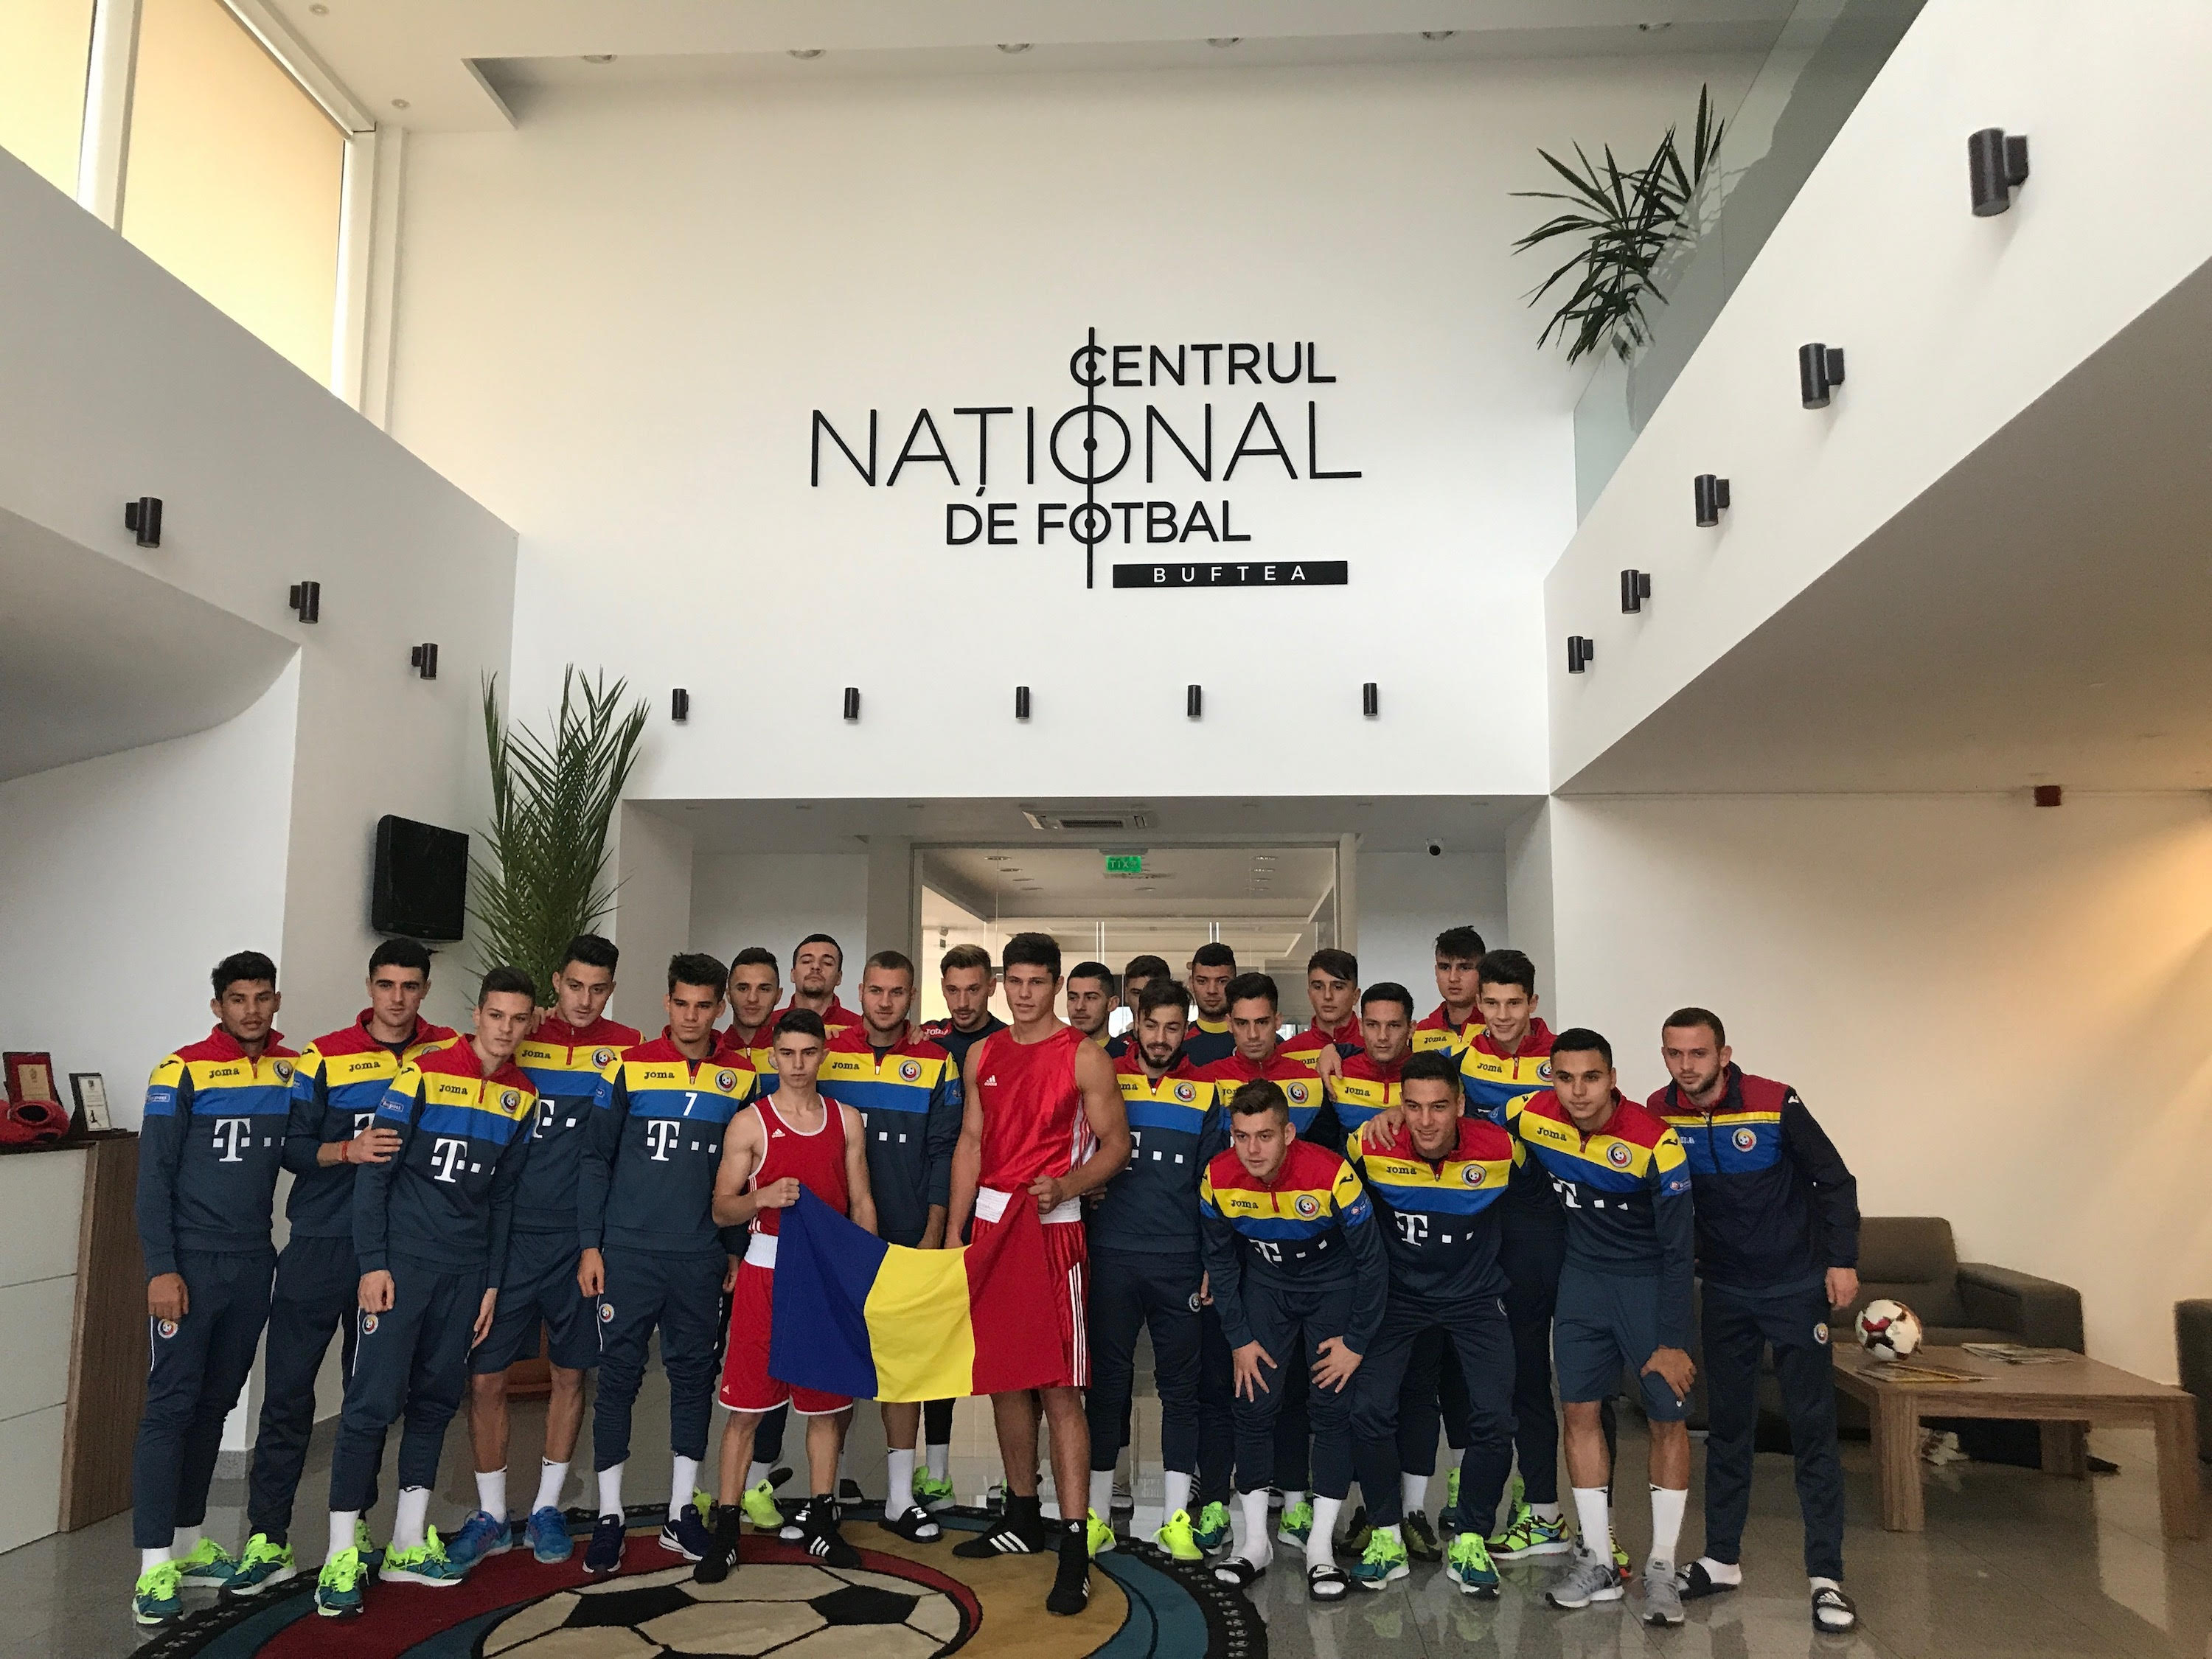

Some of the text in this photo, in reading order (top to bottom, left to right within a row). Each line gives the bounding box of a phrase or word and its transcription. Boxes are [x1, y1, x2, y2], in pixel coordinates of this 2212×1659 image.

[1070, 342, 1336, 386] CENTRUL
[811, 401, 1362, 496] NAȚIONAL
[947, 501, 1251, 546] DE FOTBAL
[1153, 565, 1306, 582] BUFTEA
[684, 1092, 698, 1116] 7
[214, 1118, 251, 1162] T
[432, 1138, 468, 1183] T
[647, 1120, 681, 1161] T
